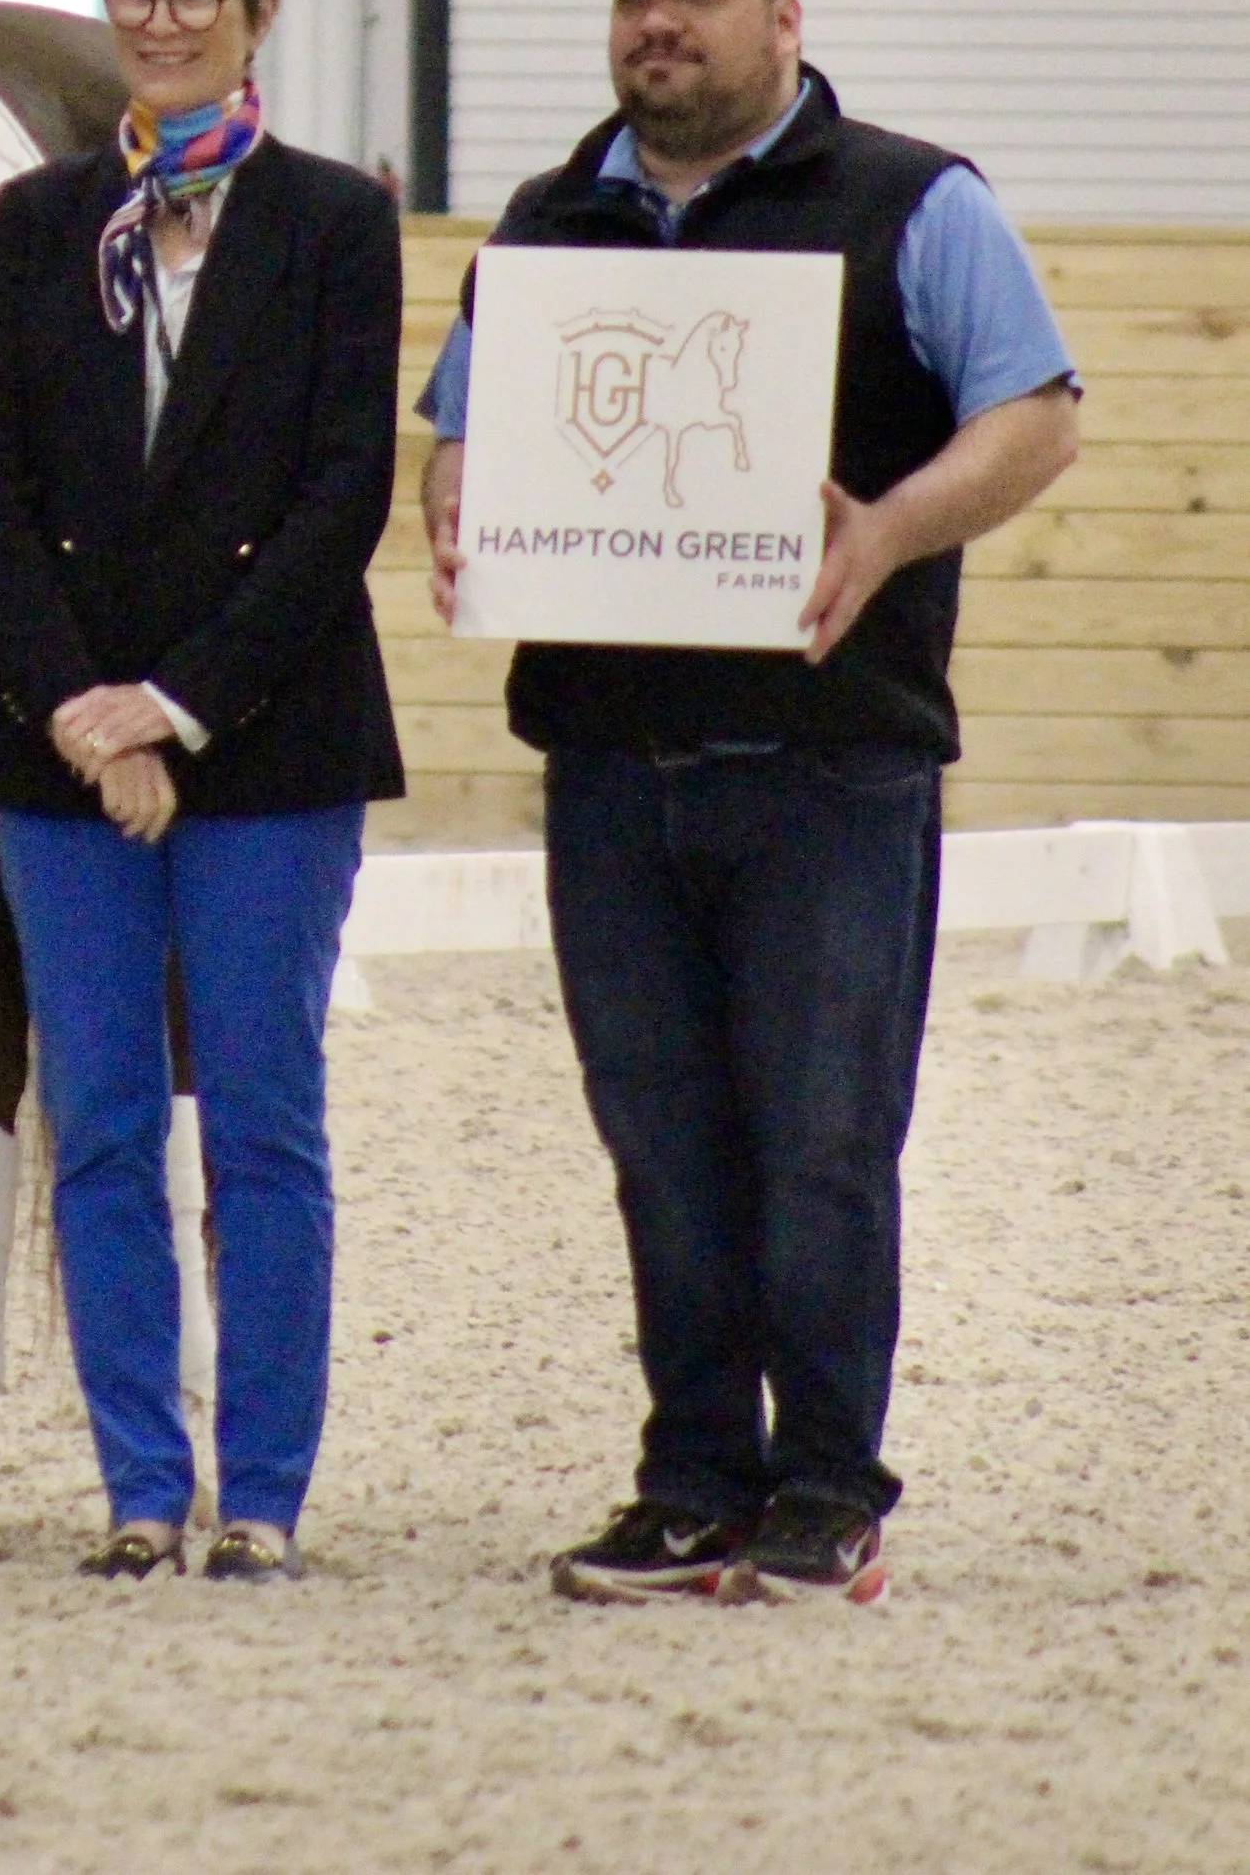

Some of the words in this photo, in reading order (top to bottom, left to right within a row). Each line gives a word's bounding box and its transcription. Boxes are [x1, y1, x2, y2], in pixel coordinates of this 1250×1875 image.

[477, 526, 664, 559] HAMPTON
[676, 532, 803, 562] GREEN
[716, 572, 801, 591] FARMS
